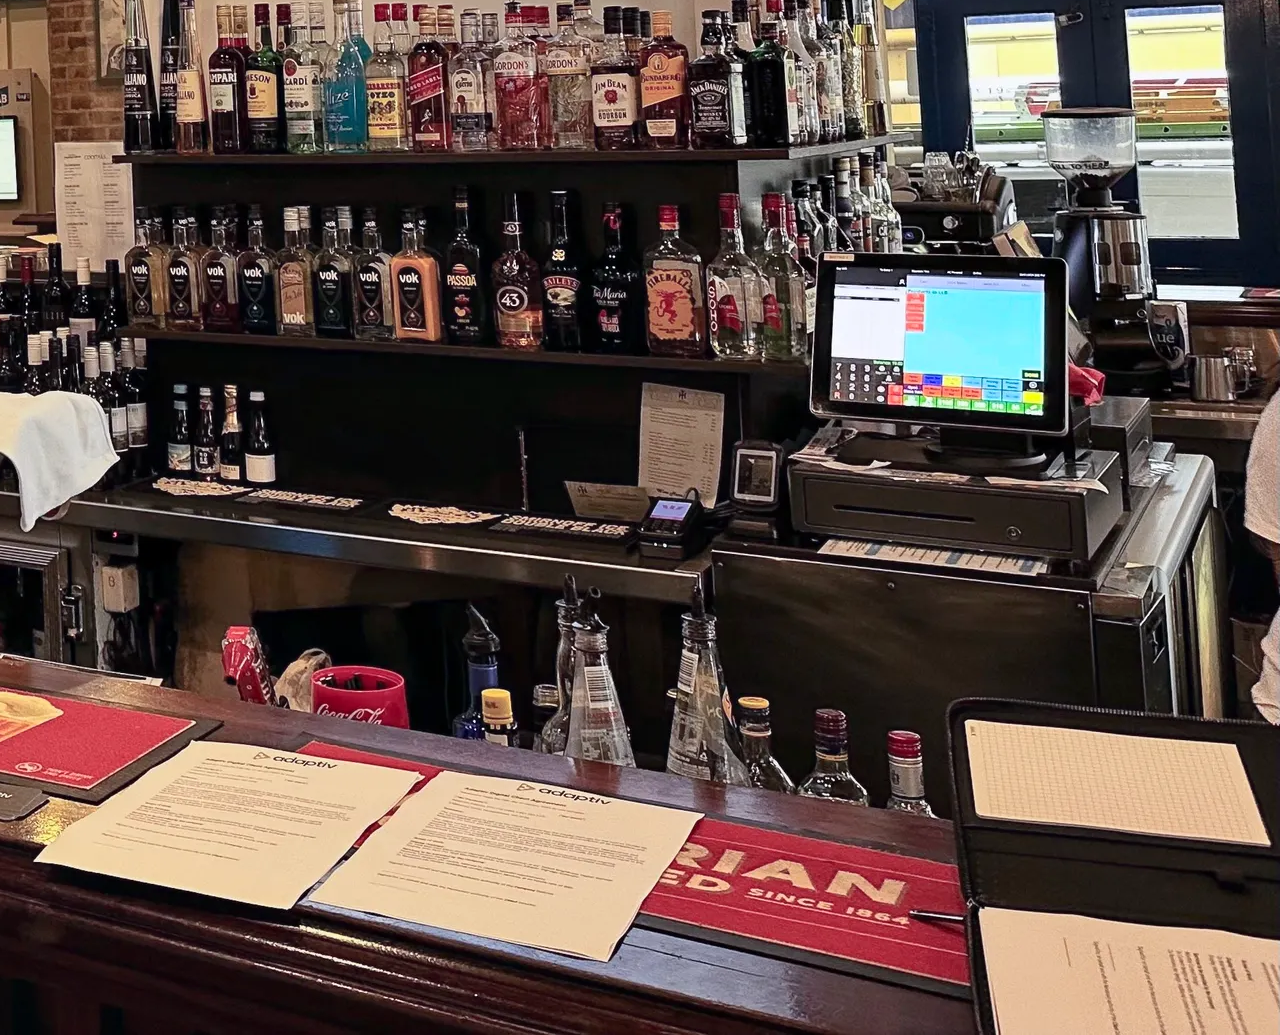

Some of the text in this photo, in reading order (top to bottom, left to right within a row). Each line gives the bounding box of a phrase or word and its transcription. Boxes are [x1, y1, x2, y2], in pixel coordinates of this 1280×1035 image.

[494, 60, 529, 71] GORDON'S
[545, 59, 578, 70] GORDON'S
[209, 72, 238, 84] AMPARI
[284, 75, 308, 86] CARDÍ
[421, 75, 441, 86] LABEL
[594, 79, 628, 95] JIM BEAM
[690, 86, 705, 96] JACK
[597, 111, 628, 120] BOURBON
[542, 277, 579, 290] BAILEYS
[647, 273, 691, 290] FIREBALL
[600, 285, 627, 299] Maria
[501, 294, 520, 307] 43
[708, 286, 718, 332] SOHO
[836, 363, 871, 373] 7 8 9
[849, 383, 856, 391] 2
[864, 384, 870, 392] 3
[273, 754, 338, 770] adaptiv
[538, 786, 612, 806] adaptiv
[659, 868, 911, 926] ED SINCE 1864
